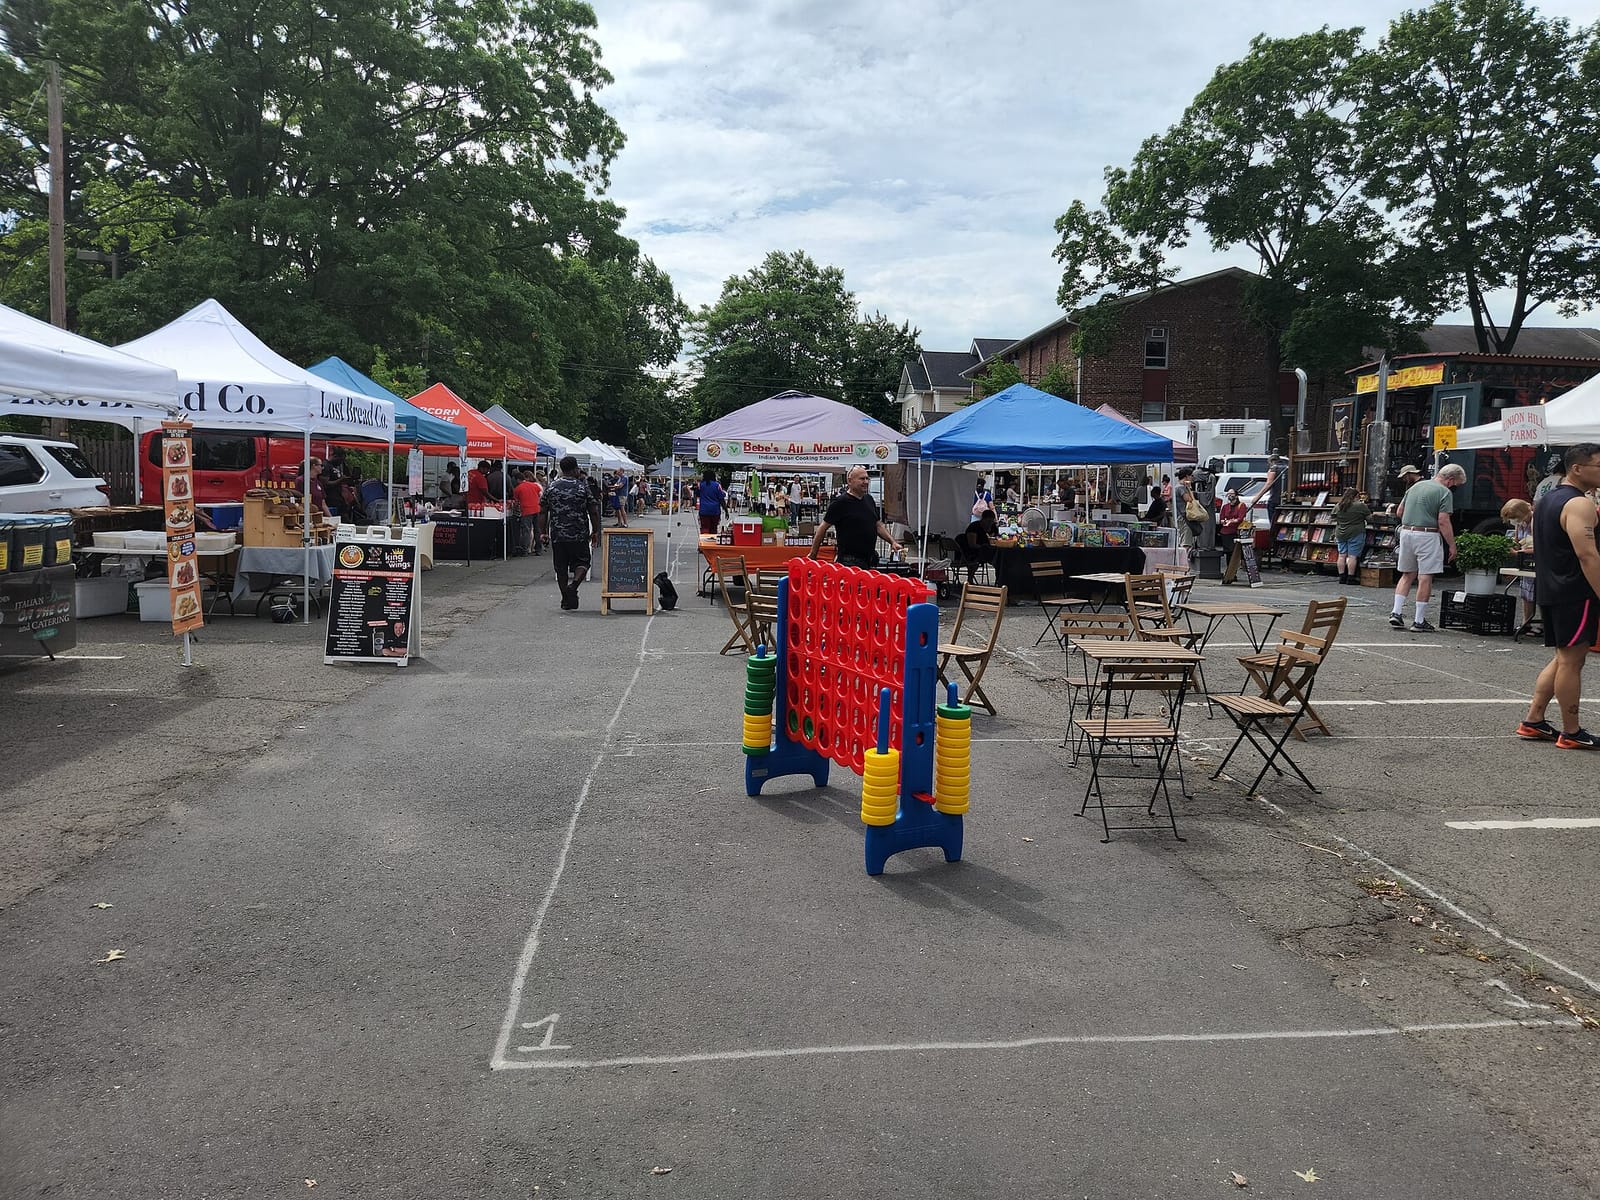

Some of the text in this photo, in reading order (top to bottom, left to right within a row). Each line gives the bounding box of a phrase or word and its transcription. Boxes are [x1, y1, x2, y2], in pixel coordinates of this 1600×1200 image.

[218, 384, 274, 415] Co.
[320, 390, 388, 429] Lost Bread Co.
[1503, 412, 1545, 432] UNION HILL
[1510, 428, 1538, 441] FARMS
[467, 440, 493, 448] AUTISM
[743, 441, 779, 453] Bebe's
[813, 443, 854, 453] Natural
[1116, 479, 1139, 489] WINERY
[384, 552, 404, 562] king
[388, 561, 411, 570] wings
[14, 596, 44, 610] ITALIAN
[18, 614, 70, 633] and CATERING
[517, 1013, 571, 1052] 1
